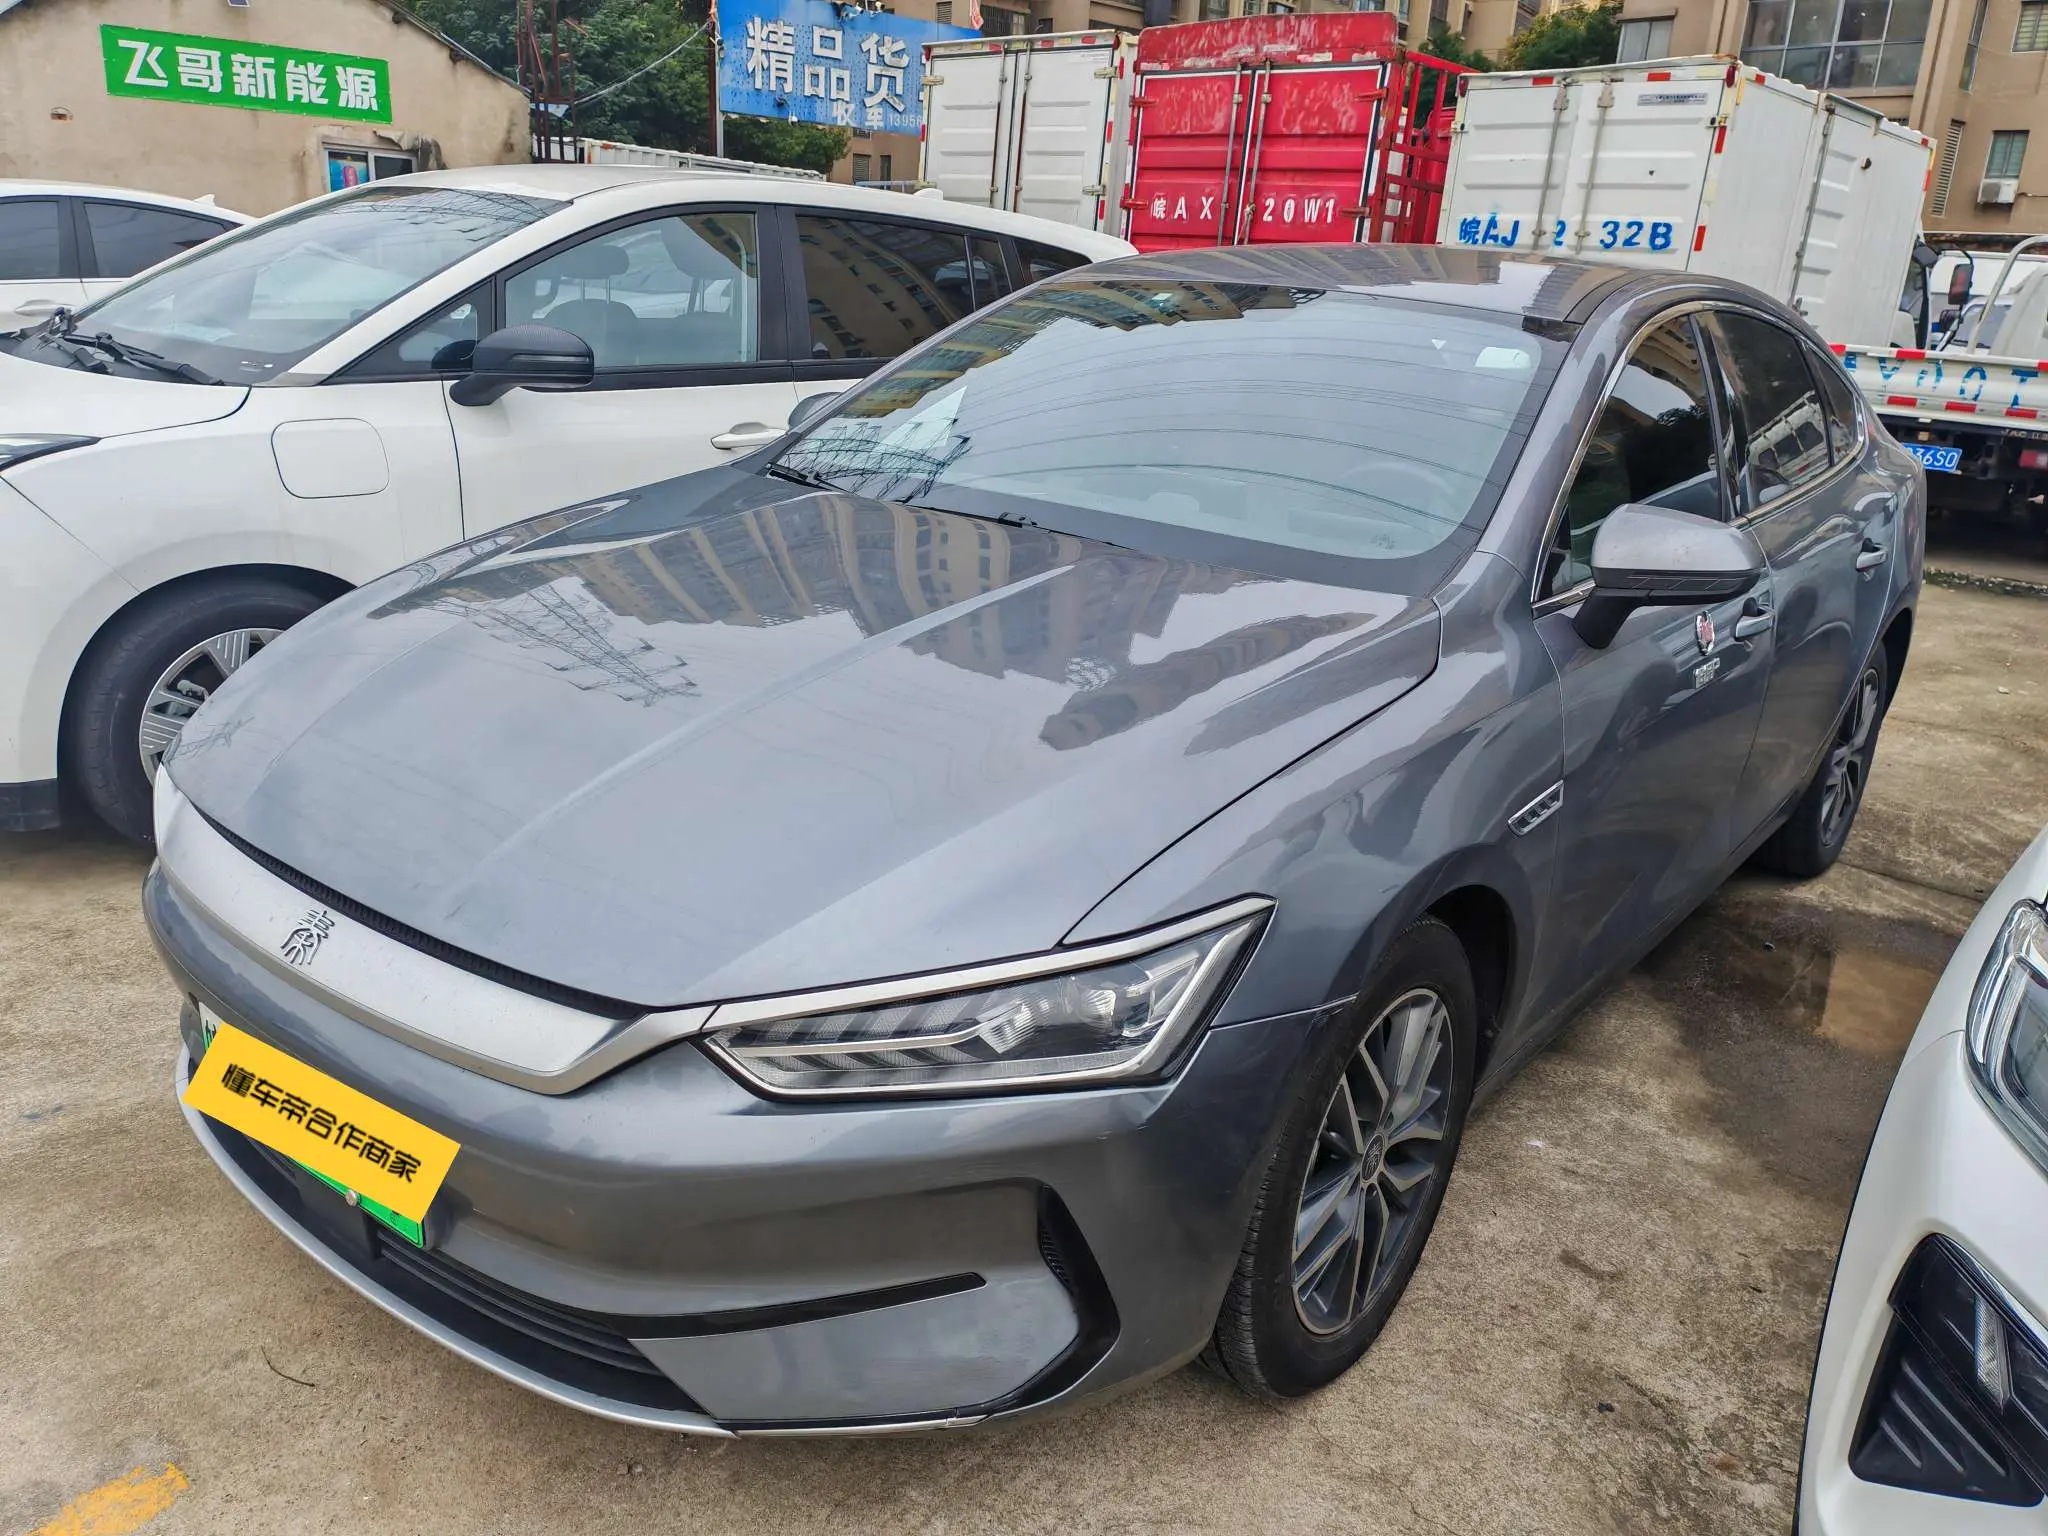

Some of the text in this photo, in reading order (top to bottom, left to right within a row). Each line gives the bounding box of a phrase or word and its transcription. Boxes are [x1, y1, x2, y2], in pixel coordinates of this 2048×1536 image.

[117, 39, 379, 111] 飞哥新能源
[747, 16, 924, 113] 精品货
